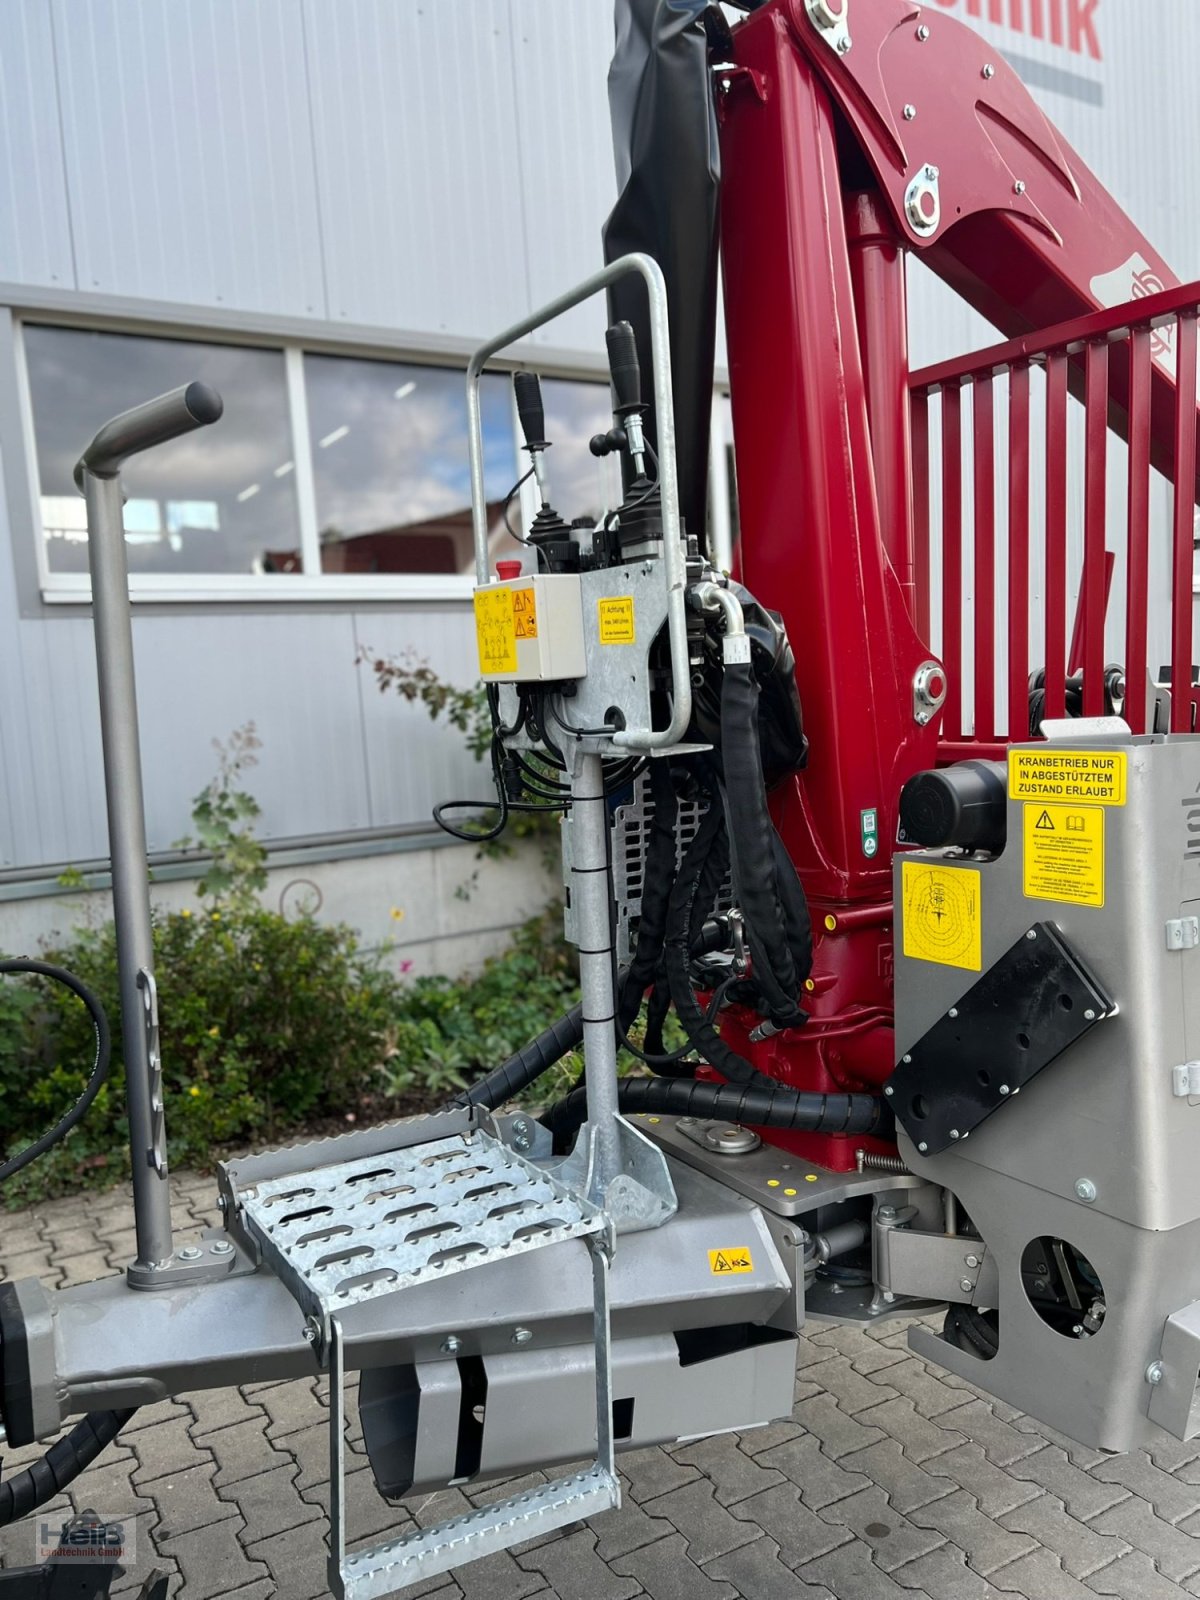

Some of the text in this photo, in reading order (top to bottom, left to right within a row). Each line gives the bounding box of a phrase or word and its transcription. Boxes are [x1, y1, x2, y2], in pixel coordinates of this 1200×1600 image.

[1018, 757, 1115, 769] KRANBETRIEB NUR
[1020, 770, 1113, 783] IN ABGESTÜTZTEM
[1018, 783, 1115, 797] ZUSTAND ERLAUBT
